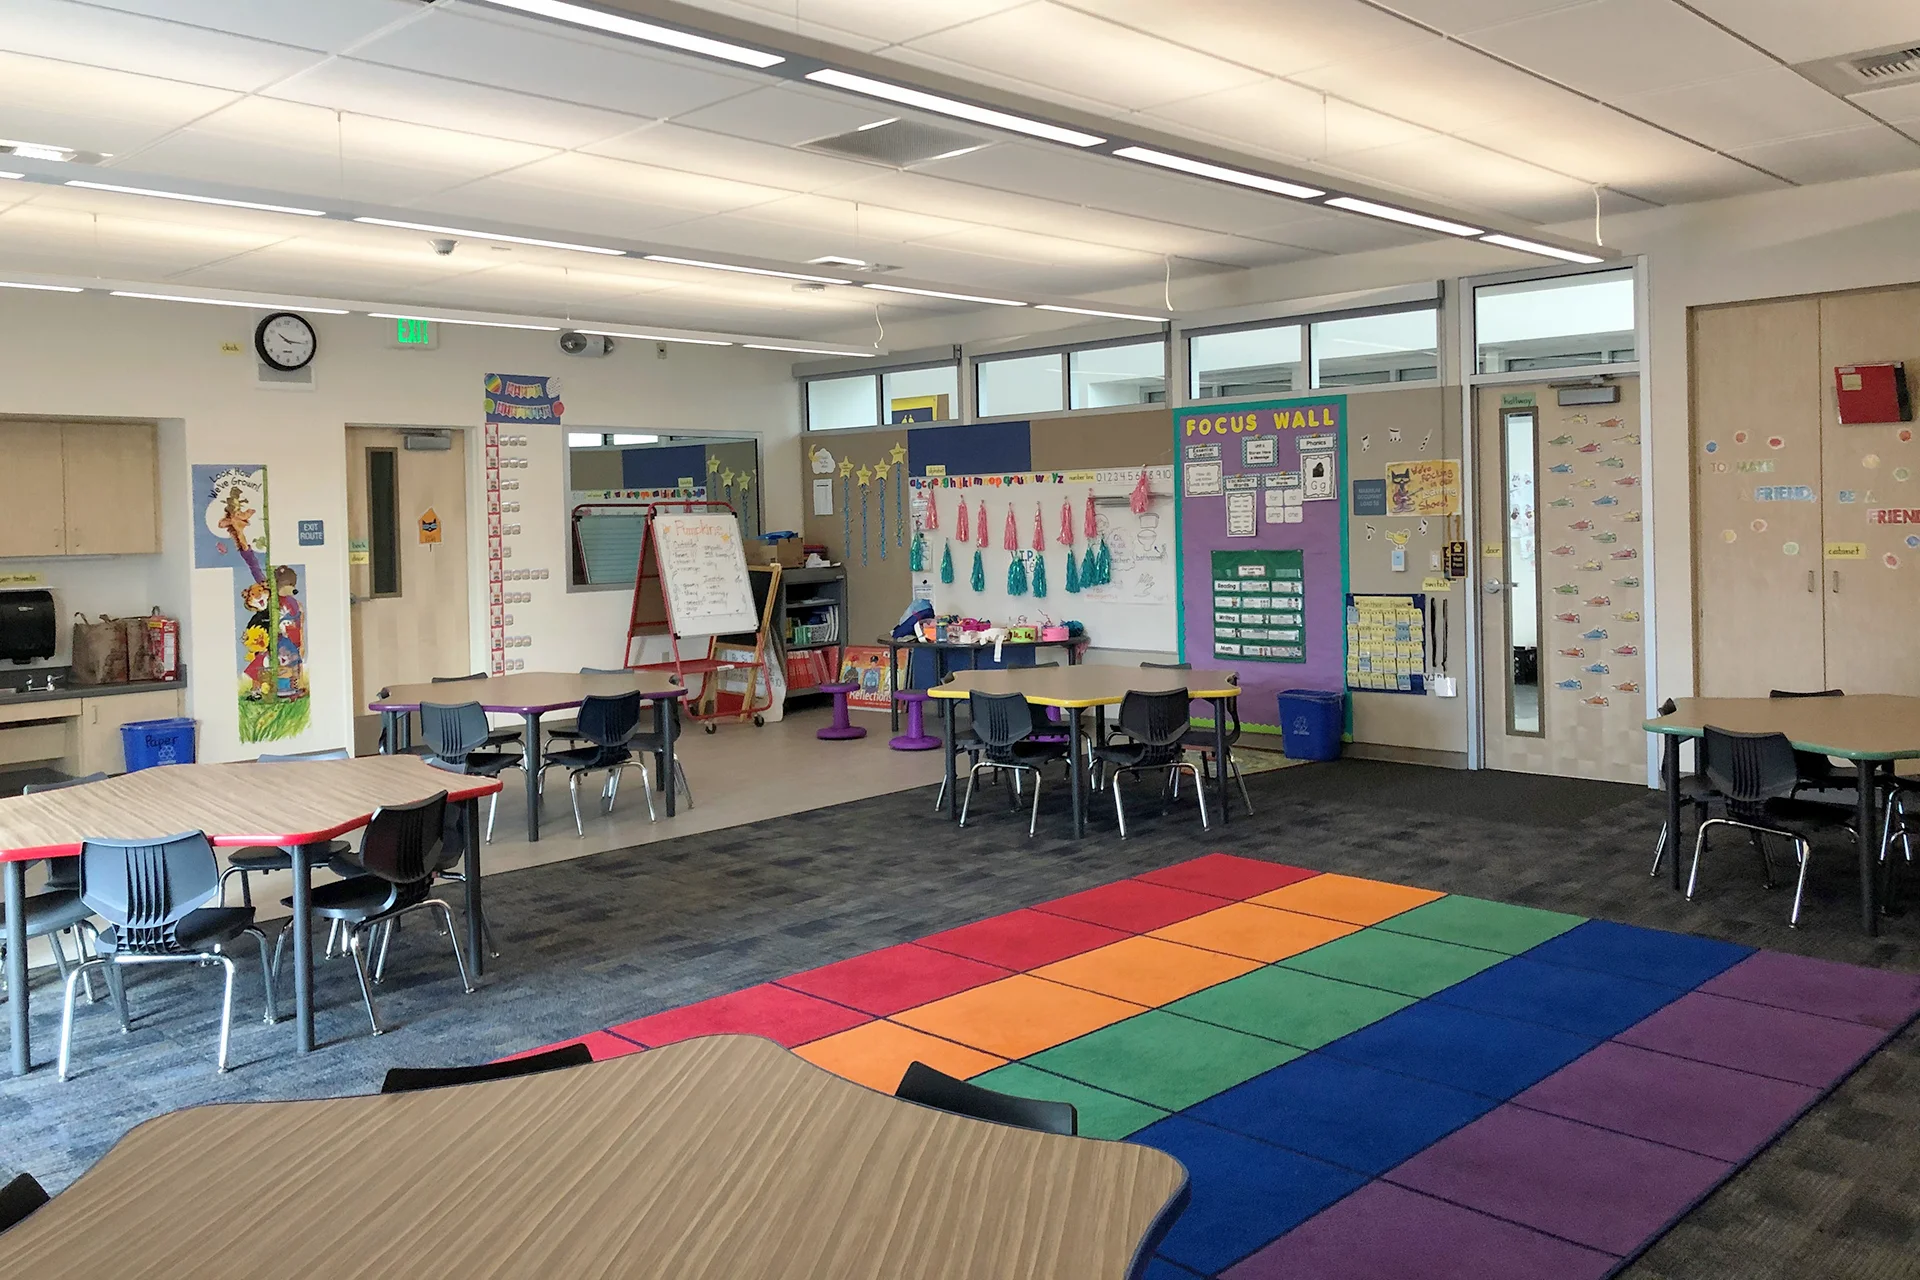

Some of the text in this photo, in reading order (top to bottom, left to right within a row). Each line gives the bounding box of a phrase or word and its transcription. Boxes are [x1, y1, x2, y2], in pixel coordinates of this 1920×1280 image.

[398, 318, 429, 344] EXIT
[1503, 396, 1533, 407] hallway
[1186, 408, 1335, 436] FOCUS WALL
[1710, 462, 1727, 474] TO
[209, 467, 252, 483] Look How
[208, 476, 262, 499] We've Grown!
[1754, 485, 1817, 503] FRIEND,
[1839, 490, 1857, 504] BE
[303, 523, 319, 532] EXIT
[674, 519, 724, 537] Pumpkins
[299, 532, 323, 540] ROUTE
[1486, 546, 1500, 554] door
[1217, 582, 1237, 590] Reading
[1425, 579, 1448, 588] switch
[849, 690, 892, 703] Reflections
[145, 734, 179, 749] Paper
